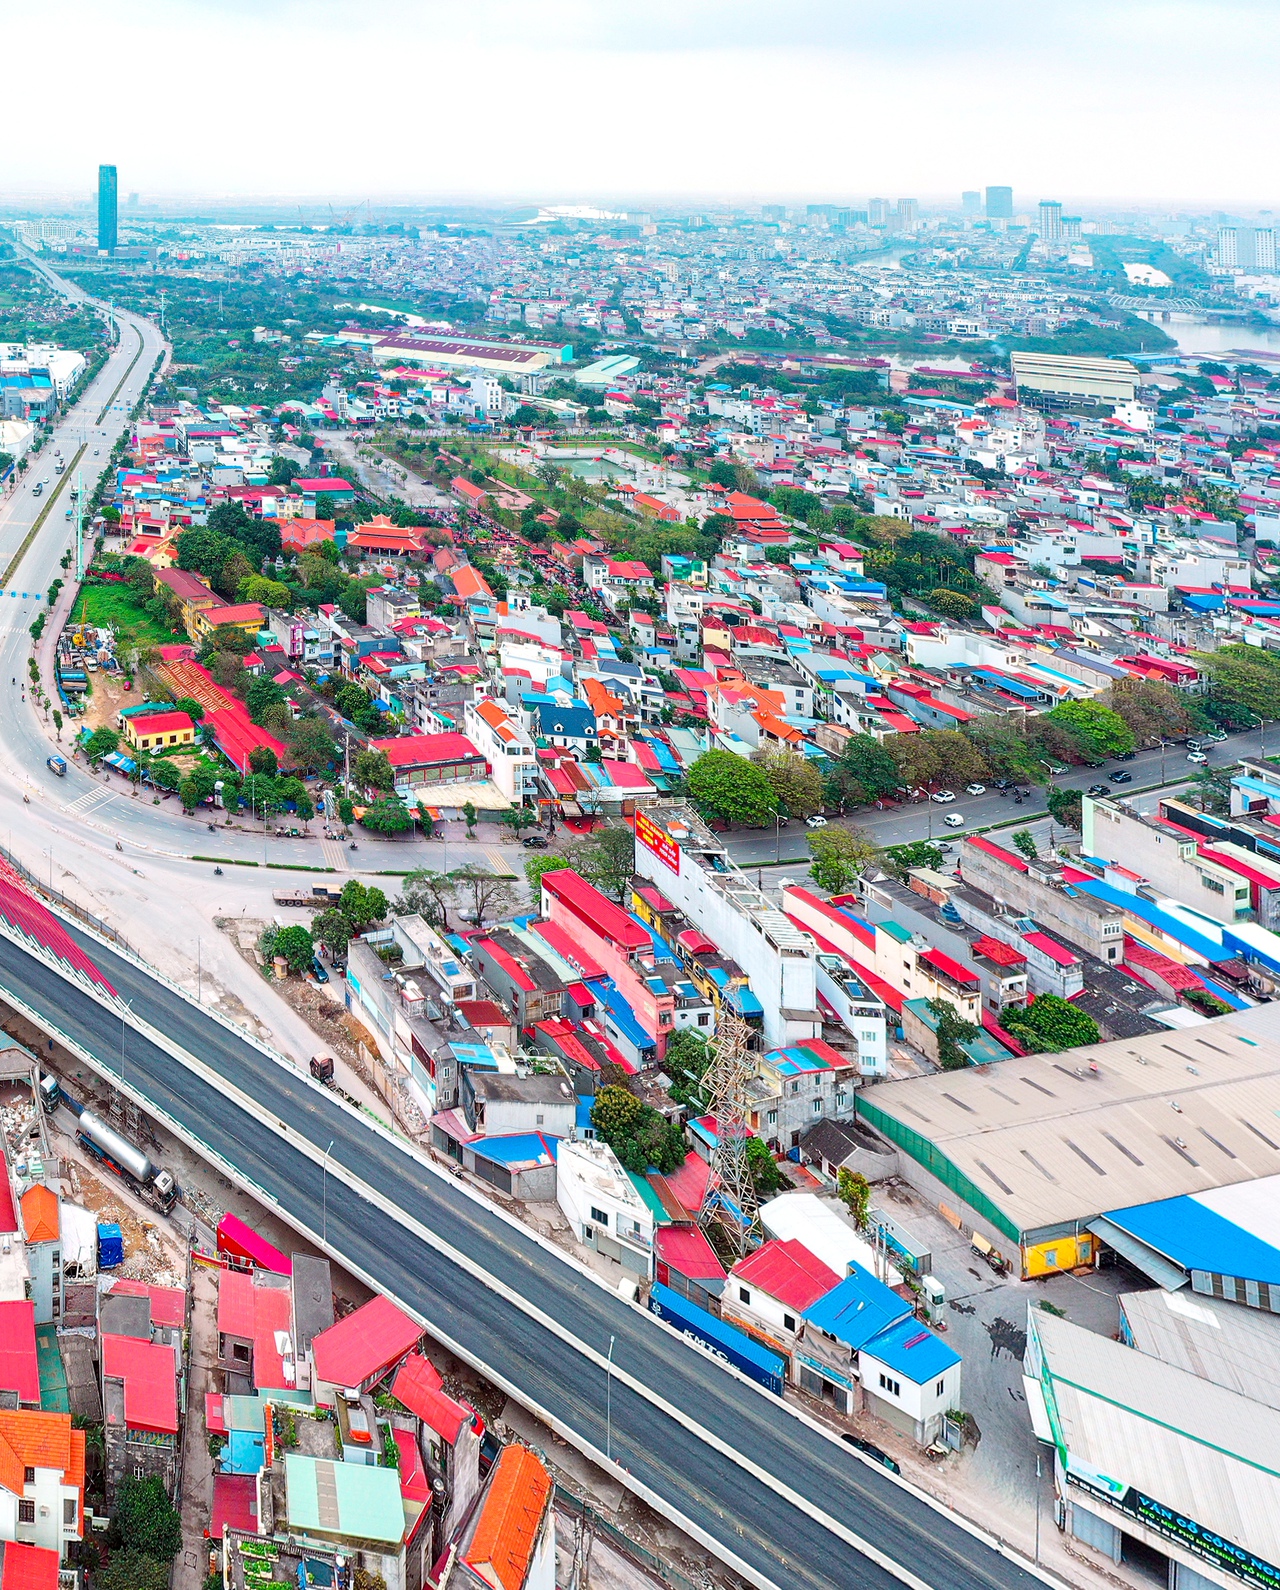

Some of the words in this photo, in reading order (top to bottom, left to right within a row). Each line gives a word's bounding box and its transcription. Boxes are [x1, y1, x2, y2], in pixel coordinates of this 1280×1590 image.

[682, 1328, 729, 1362] KMTC
[1176, 1517, 1199, 1534] GỖ
[1202, 1532, 1246, 1561] CÔNG
